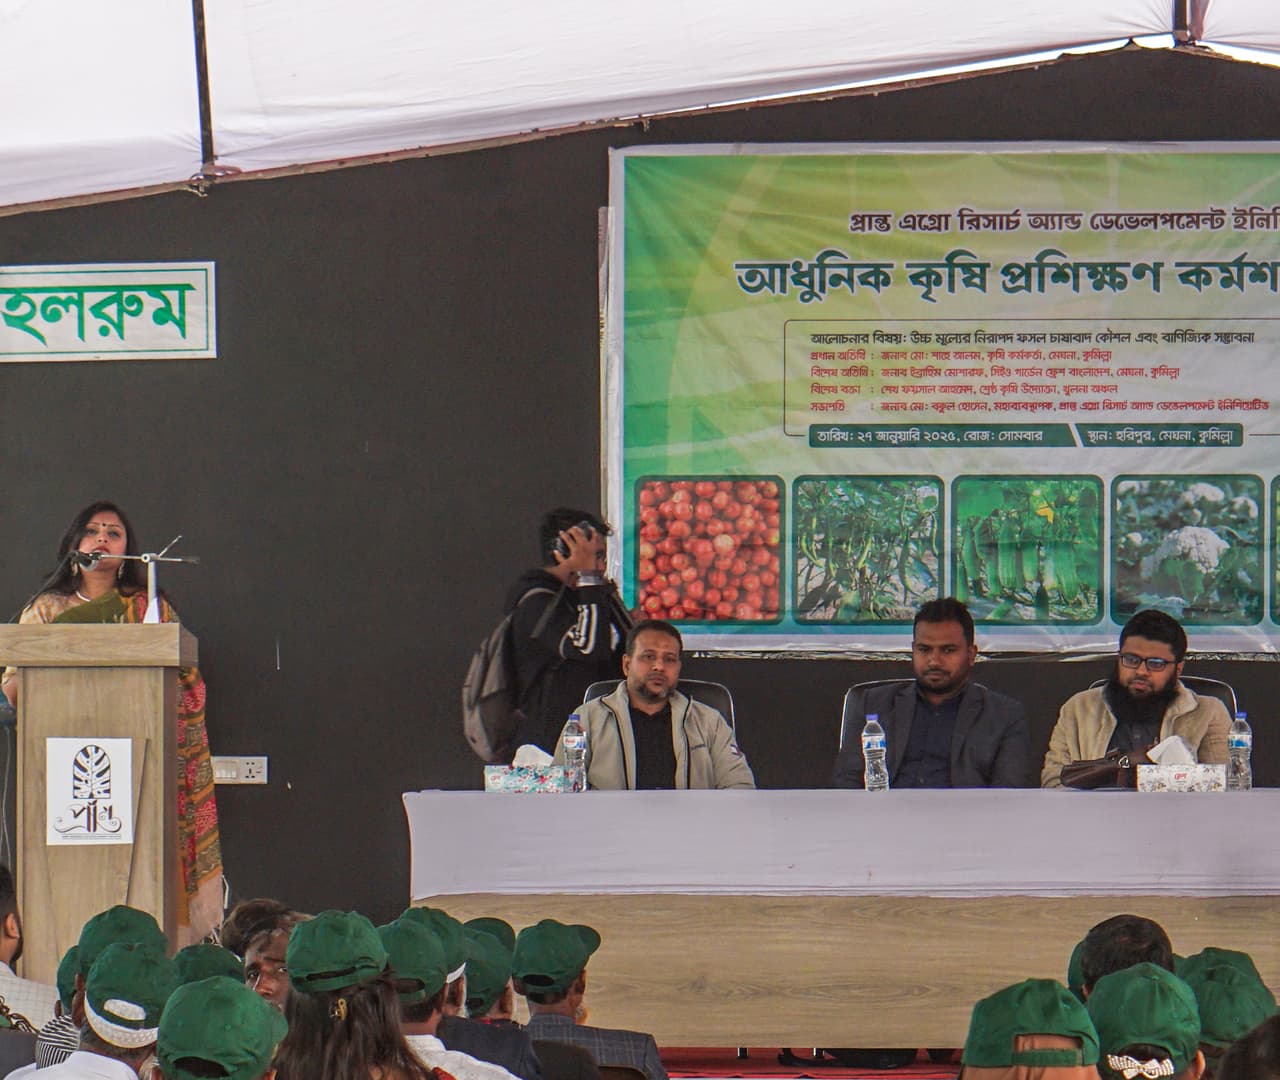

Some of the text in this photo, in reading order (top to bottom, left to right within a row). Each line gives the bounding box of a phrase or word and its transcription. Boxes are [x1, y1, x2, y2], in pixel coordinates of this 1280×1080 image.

[850, 214, 891, 231] প্রান্ত
[899, 213, 951, 232] এগ্রো
[957, 208, 1021, 231] রিসার্চ
[1028, 213, 1082, 230] অ্যান্ড
[1090, 208, 1227, 231] ডেভেলপমেন্ট
[735, 249, 894, 303] আধুনিক
[906, 249, 991, 303] কৃষি
[1000, 248, 1165, 294] প্রশিক্ষণ
[810, 332, 869, 344] আলোচনার
[910, 330, 932, 344] উচ্চ
[935, 333, 971, 346] মূল্যের
[974, 329, 1013, 344] নিরাপদ
[1017, 333, 1046, 344] ফসল
[1050, 332, 1091, 344] চাষাবাদ
[1096, 328, 1131, 344] কৌশল
[1135, 332, 1159, 345] এবং
[1161, 329, 1211, 344] বাণিজ্যিক
[1214, 332, 1255, 344] সম্ভাবনা
[858, 431, 872, 442] ২৭
[875, 428, 920, 444] জানুয়ারি
[998, 430, 1043, 442] সোমবার
[1198, 427, 1234, 444] কুমিল্লা
